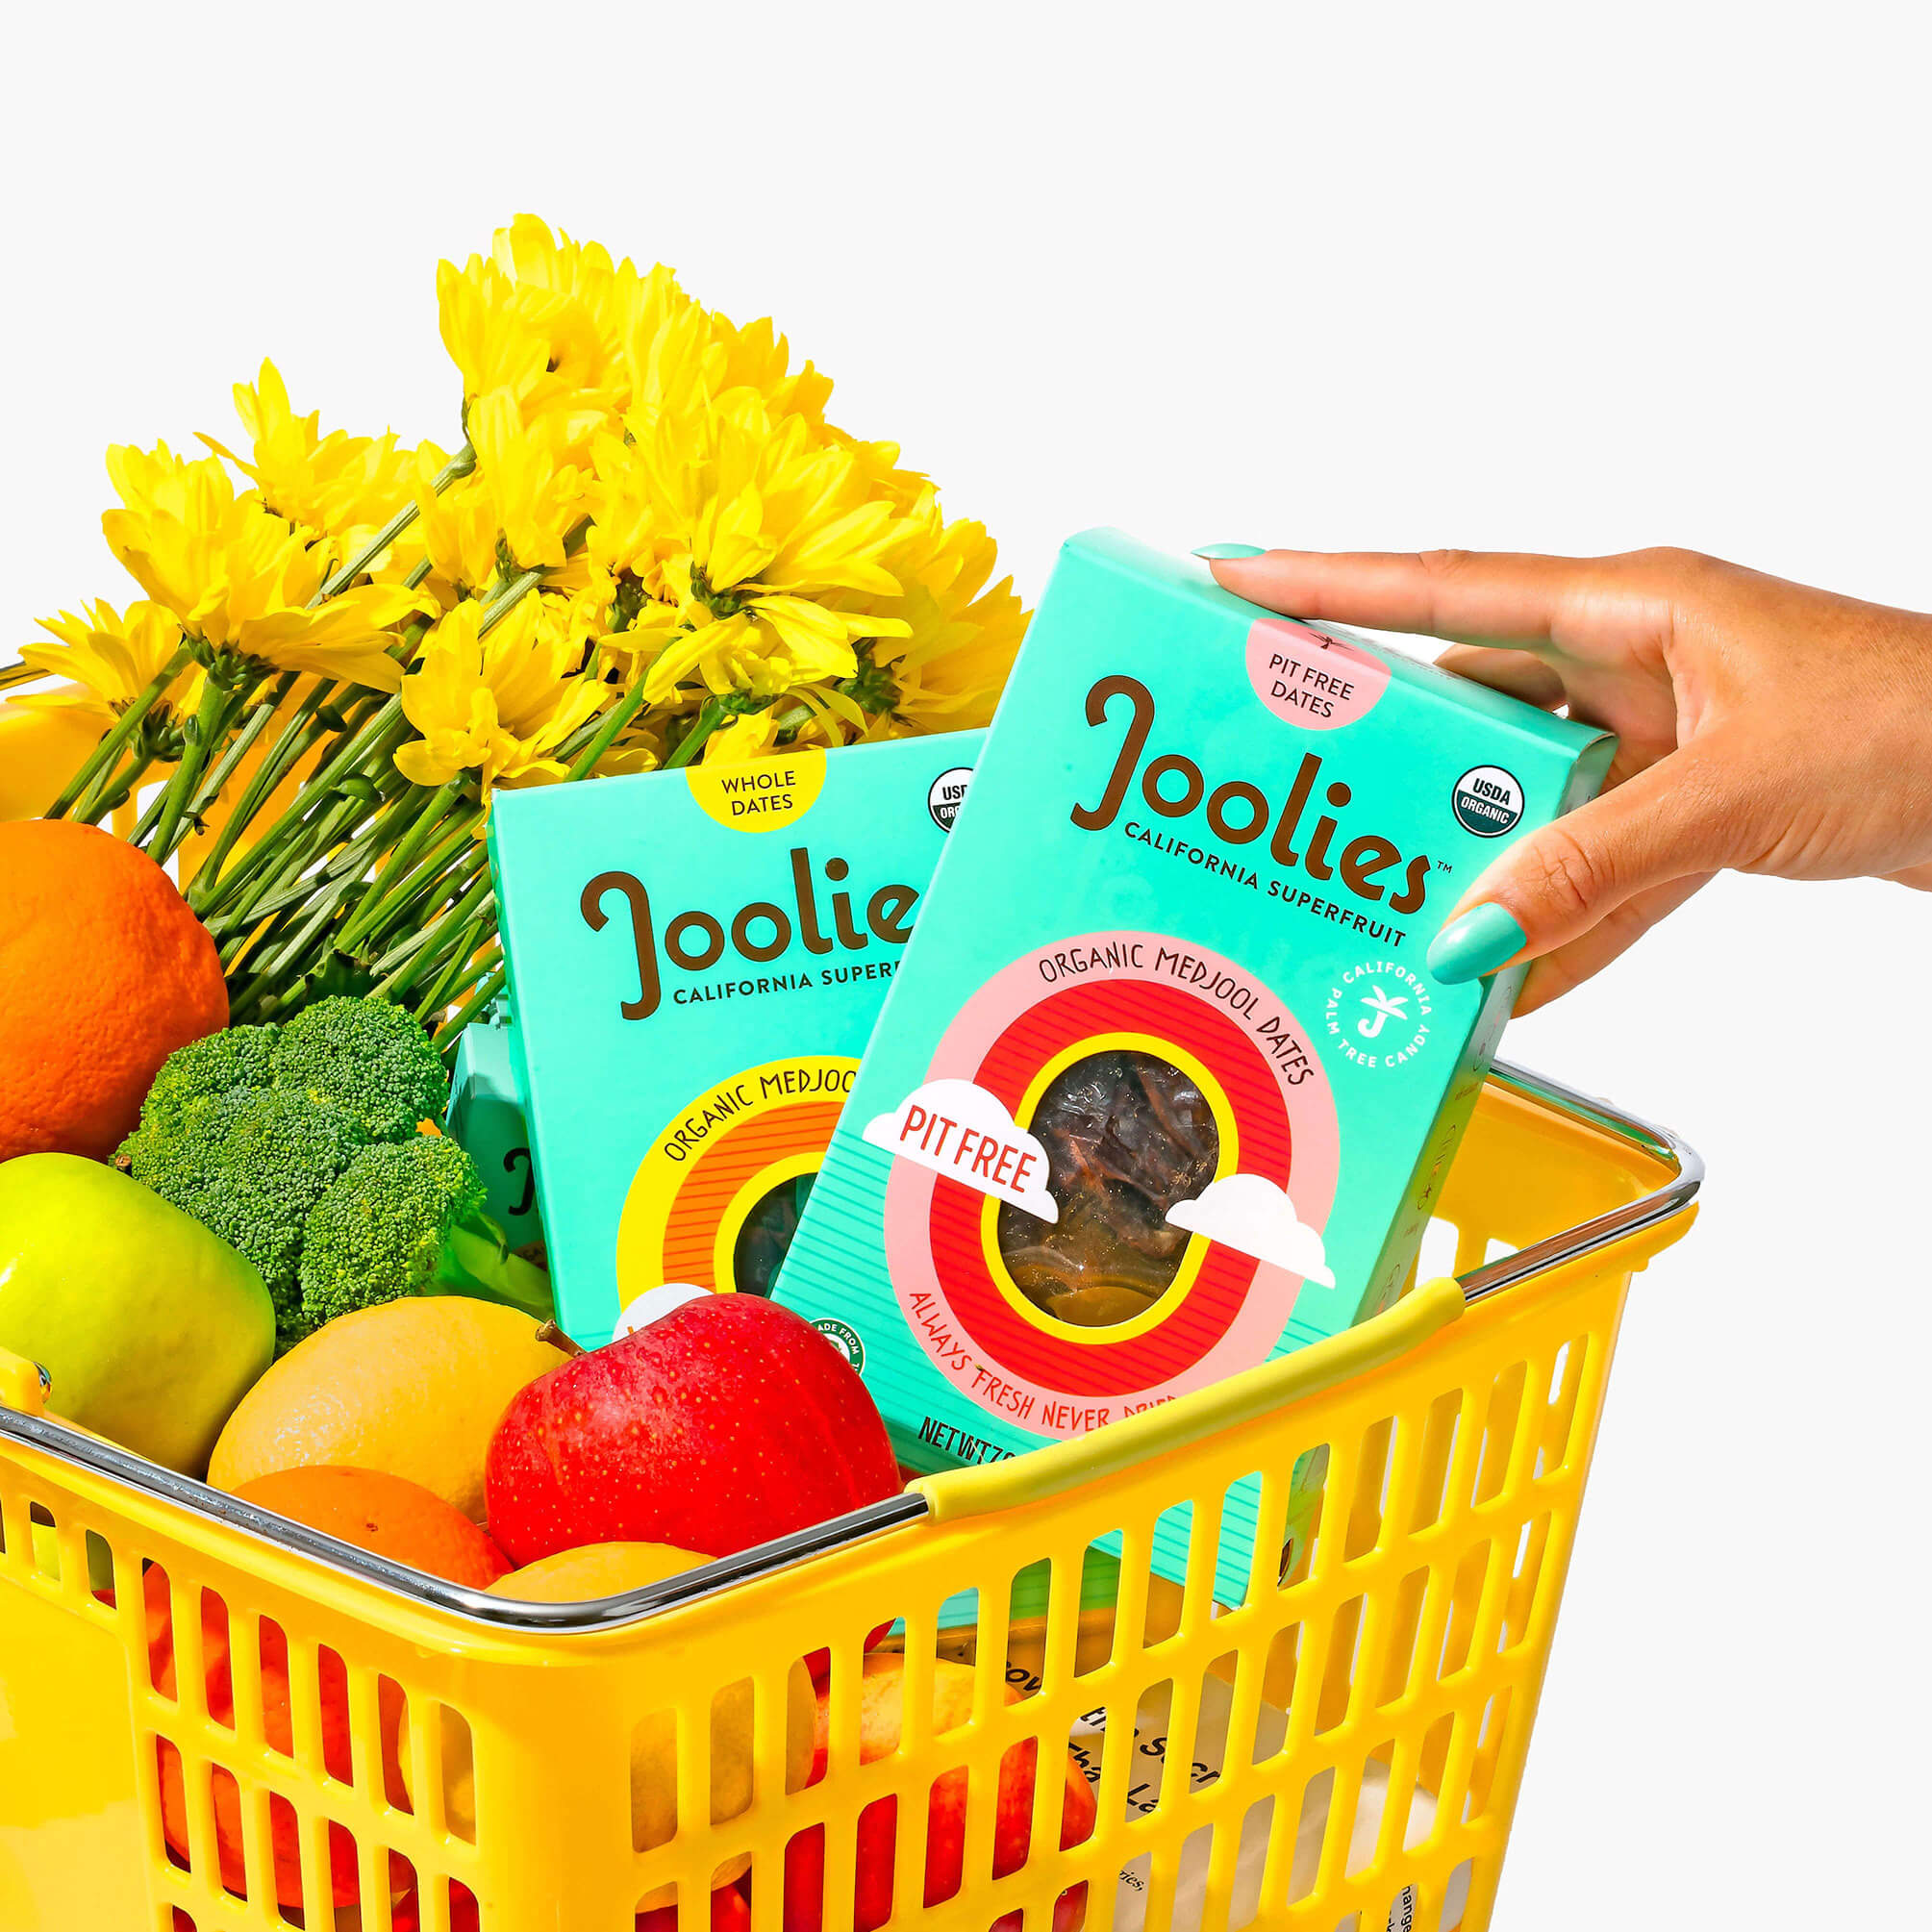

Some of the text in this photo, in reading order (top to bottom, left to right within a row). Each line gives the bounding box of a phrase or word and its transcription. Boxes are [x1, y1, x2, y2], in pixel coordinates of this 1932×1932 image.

[1268, 653, 1355, 700] PIT FREE
[1270, 680, 1335, 717] DATES
[720, 770, 797, 794] WHOLE
[729, 793, 794, 816] DATES
[1070, 675, 1432, 915] Joolies
[1472, 777, 1512, 806] USDA
[1460, 795, 1510, 825] ORGANIC
[1123, 820, 1406, 948] CALIFORNIA SUPERFRUIT
[672, 974, 814, 1006] CALIFORNIA
[1038, 939, 1315, 1087] ORGANIC MEDJOOL DATES
[1342, 961, 1432, 1016] CALIFORNIA
[1325, 987, 1431, 1068] PALM TREE CANDY
[664, 1085, 754, 1162] ORGANIC
[899, 1104, 1038, 1194] PIT FREE
[839, 1327, 860, 1355] FROM
[909, 1292, 1110, 1433] ALWAYS FRESH NEVER
